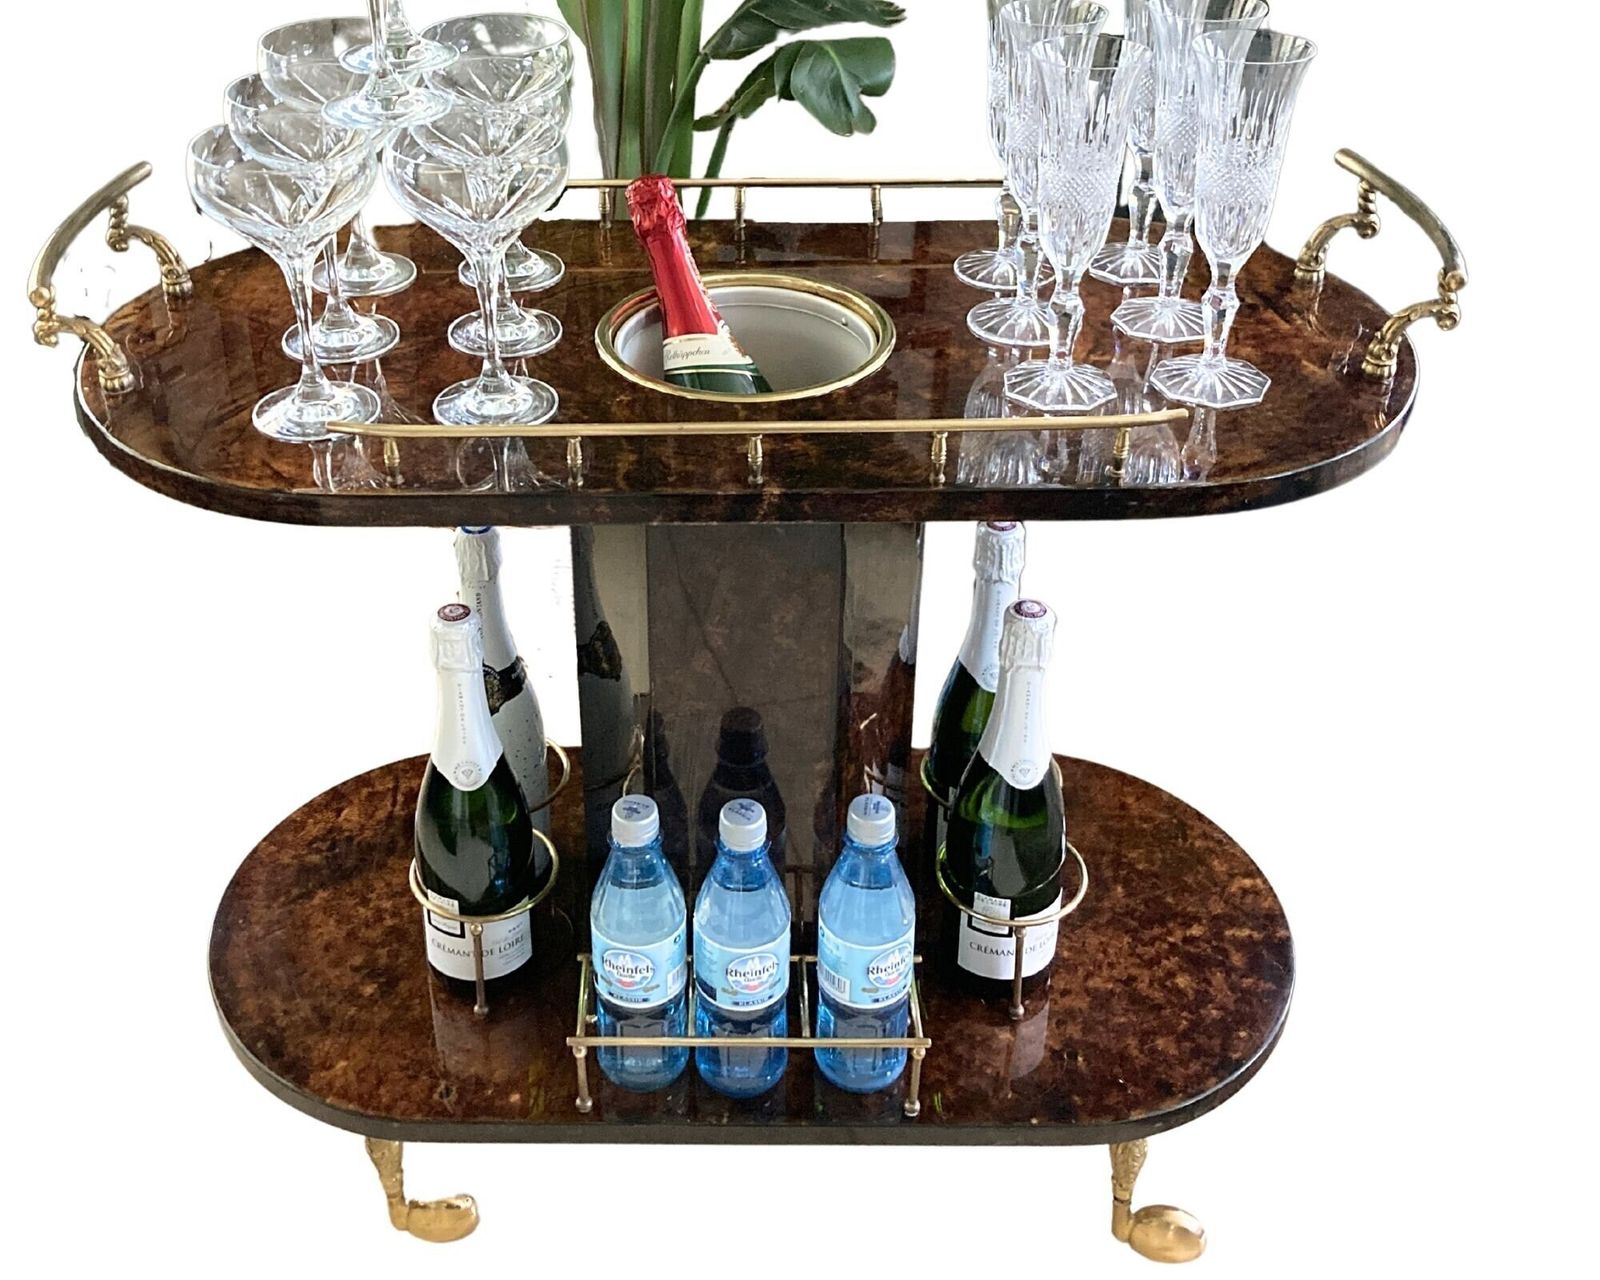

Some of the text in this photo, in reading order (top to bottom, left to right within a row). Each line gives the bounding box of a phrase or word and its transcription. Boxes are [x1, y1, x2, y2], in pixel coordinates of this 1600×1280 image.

[431, 938, 475, 958] CRÉMAN
[498, 934, 525, 954] LOIRE
[969, 941, 1015, 957] CRÉMAN
